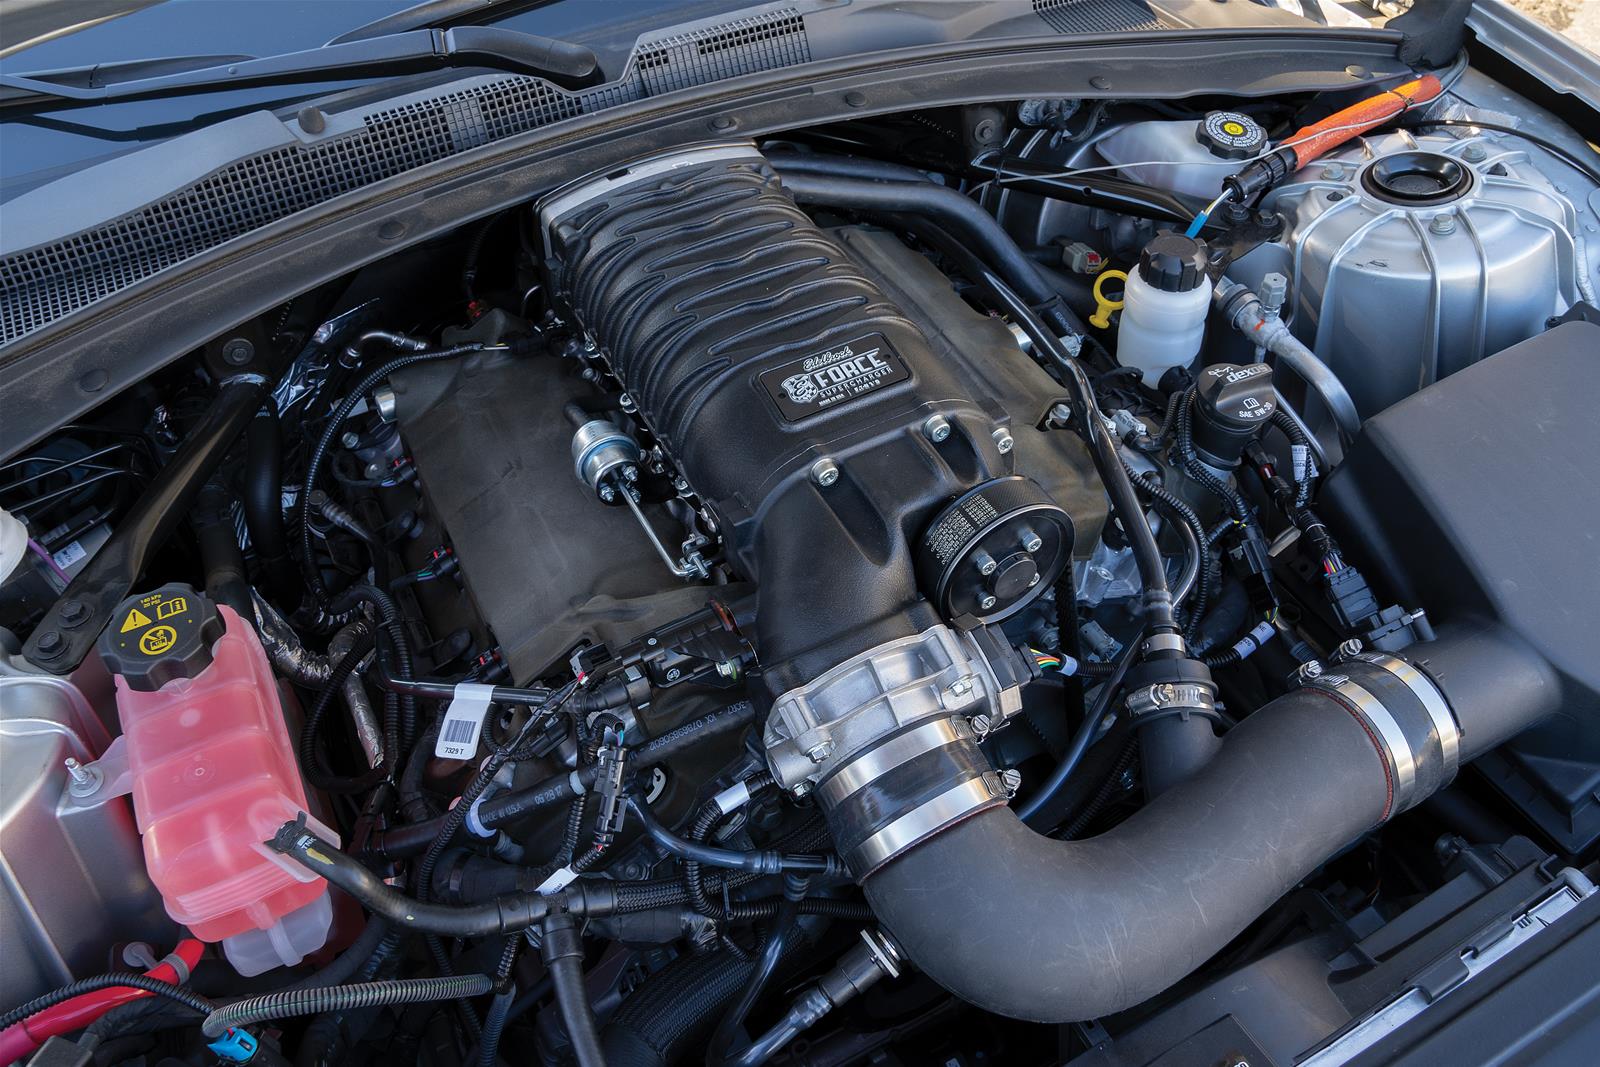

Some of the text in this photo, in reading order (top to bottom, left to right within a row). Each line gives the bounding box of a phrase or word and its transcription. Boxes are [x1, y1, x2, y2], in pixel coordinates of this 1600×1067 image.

[803, 346, 854, 371] Edelbrock
[814, 352, 887, 389] FORCE
[820, 366, 893, 398] SUPERCHARGER
[1226, 364, 1269, 383] dexos
[444, 746, 460, 755] 7329
